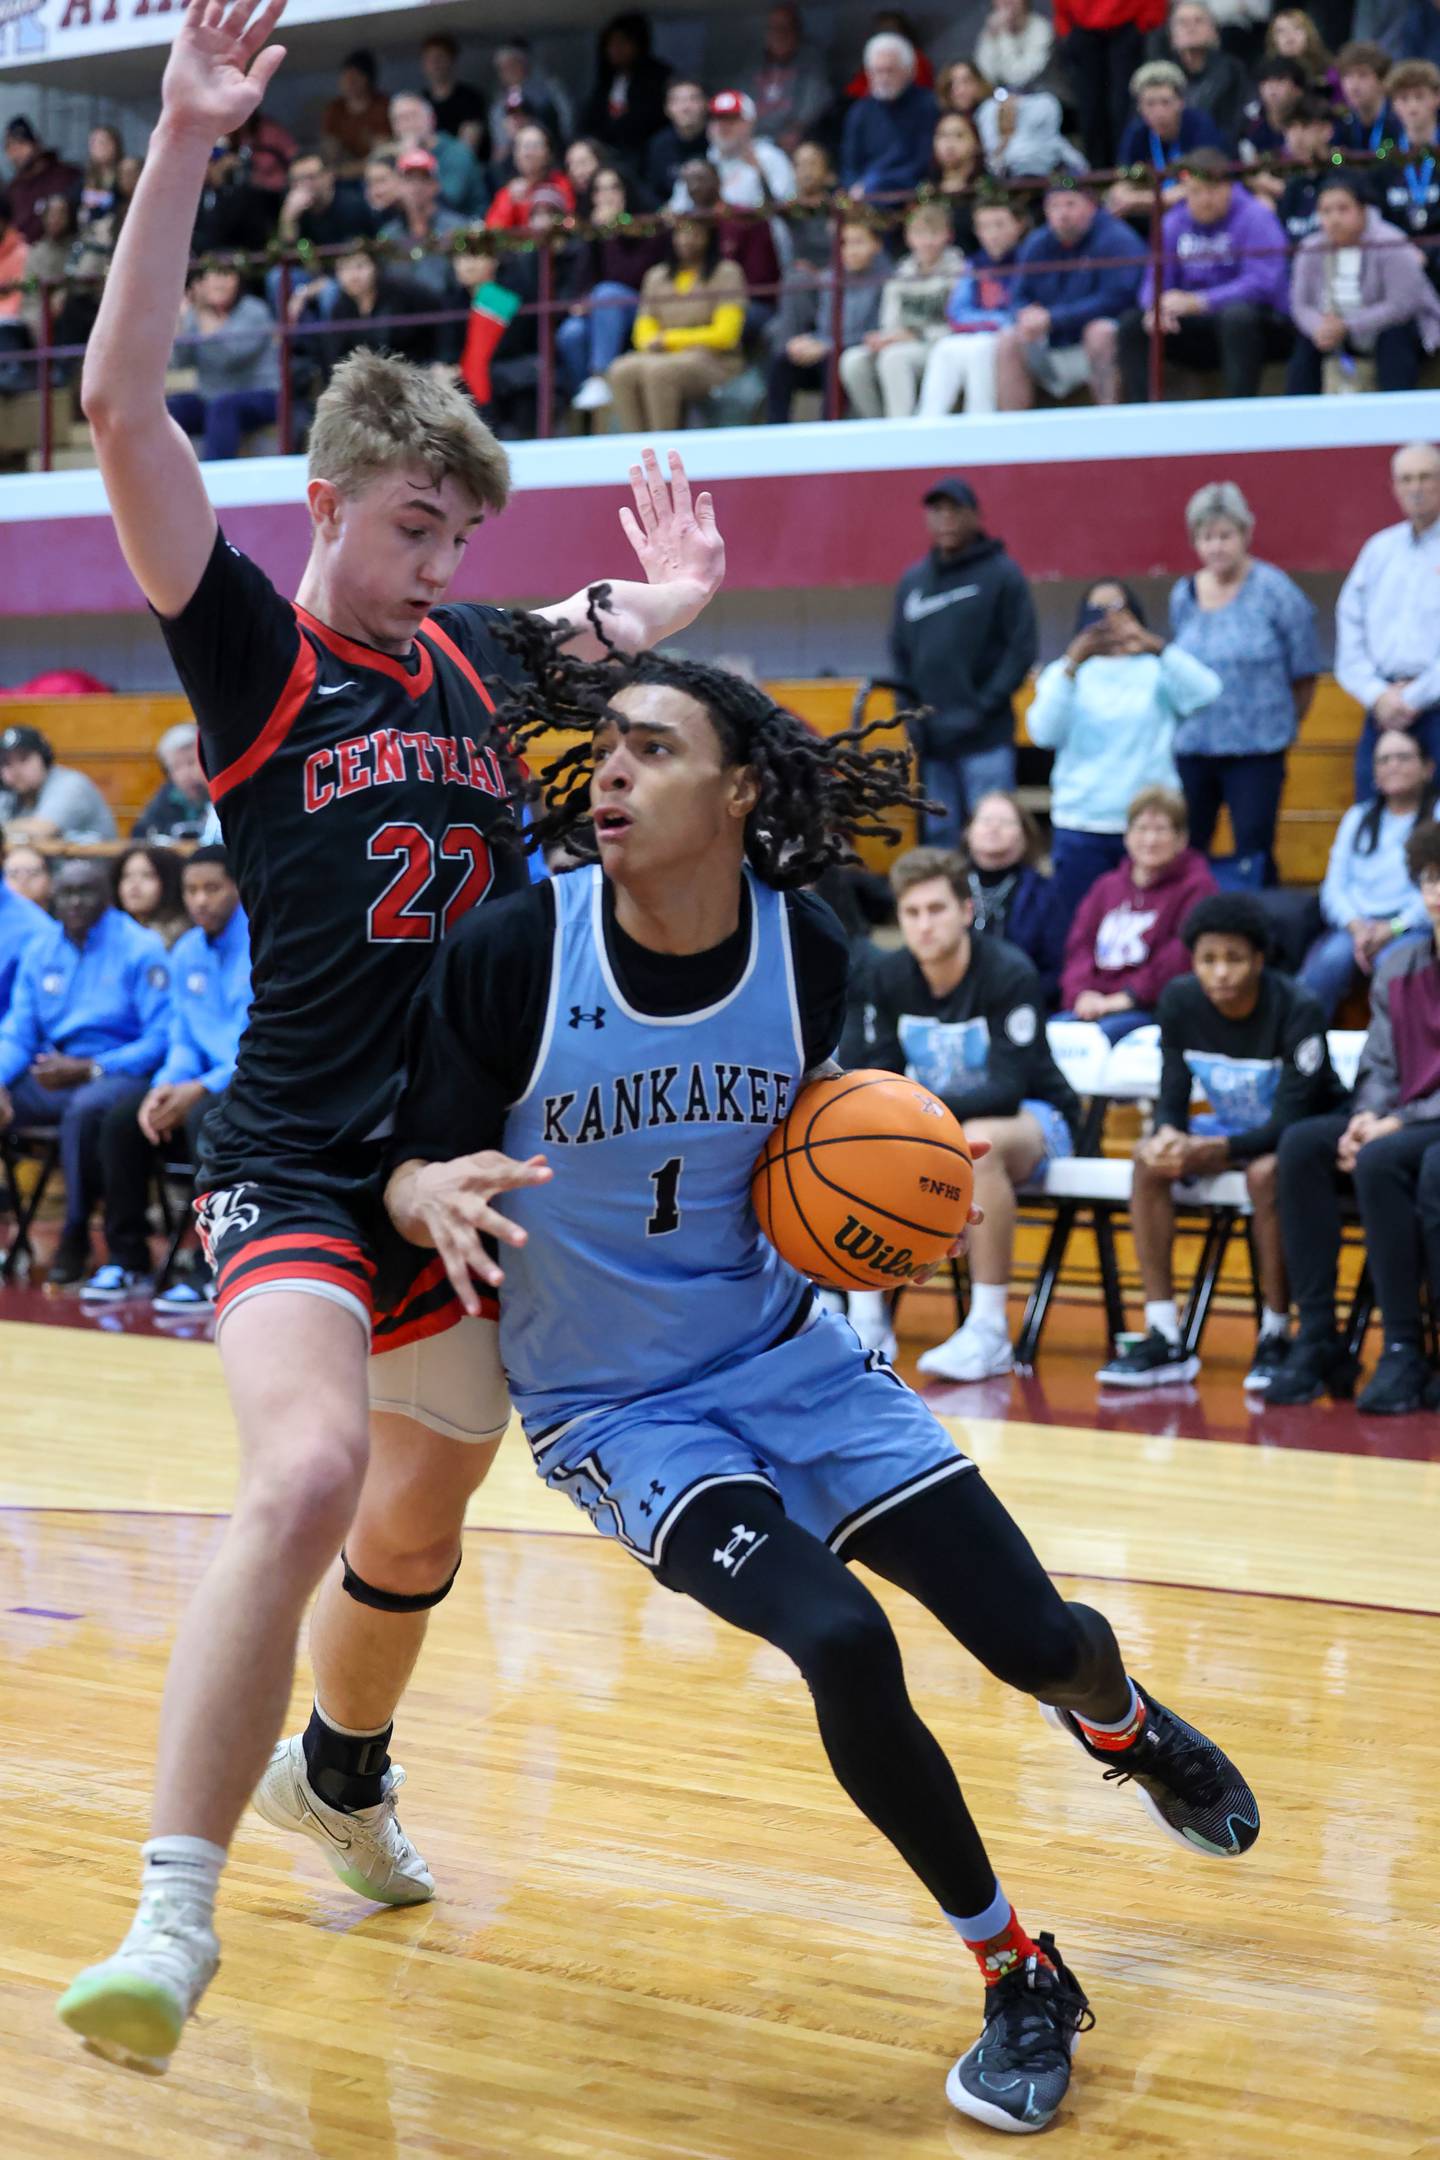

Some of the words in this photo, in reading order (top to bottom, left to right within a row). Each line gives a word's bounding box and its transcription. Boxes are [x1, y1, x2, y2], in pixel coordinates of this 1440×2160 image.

[367, 821, 495, 943] 22
[543, 1062, 793, 1145] KANKAKEE
[646, 1156, 684, 1238] 1
[928, 1179, 961, 1202] NFHS
